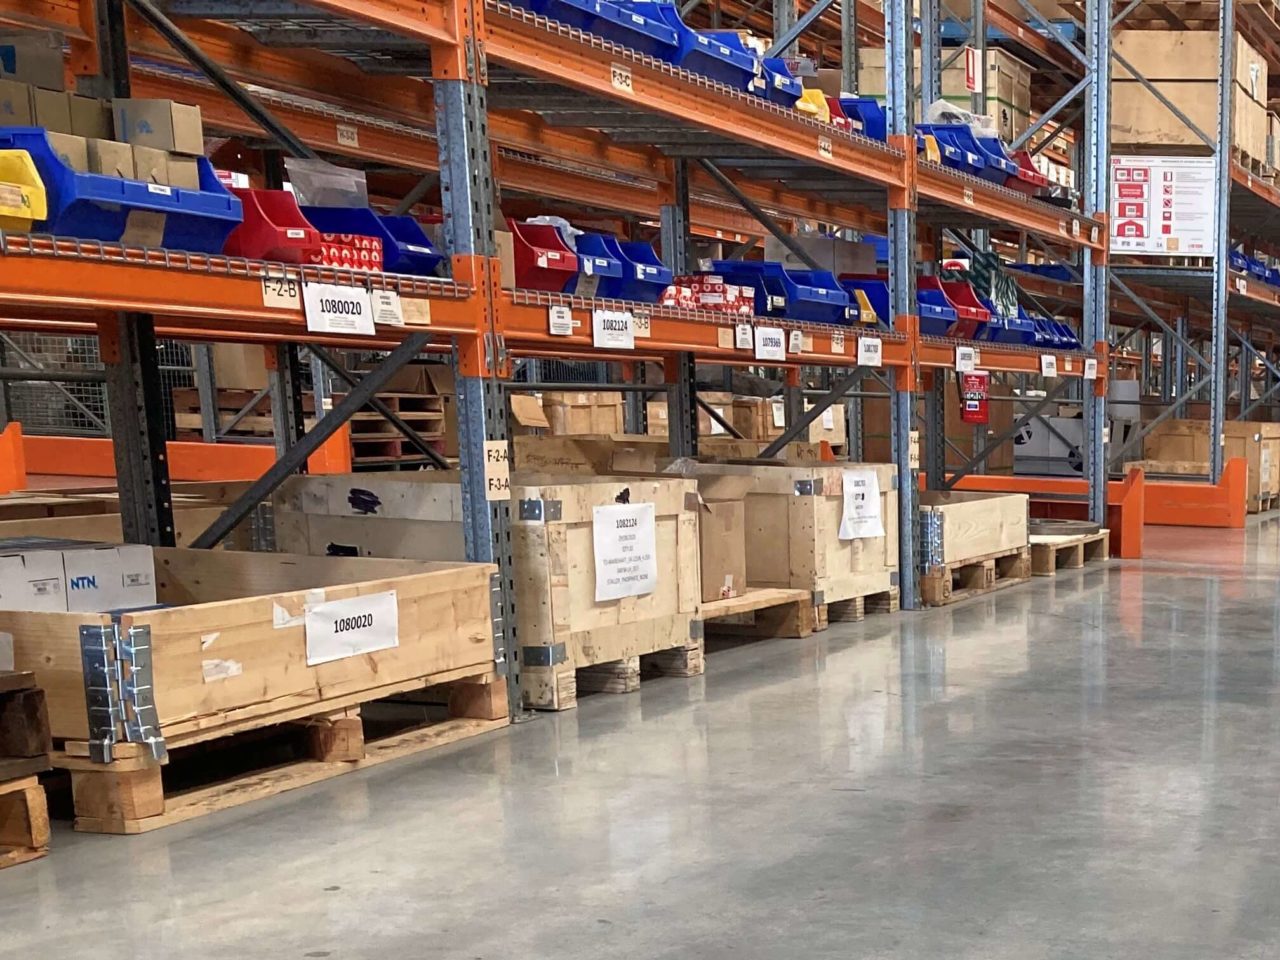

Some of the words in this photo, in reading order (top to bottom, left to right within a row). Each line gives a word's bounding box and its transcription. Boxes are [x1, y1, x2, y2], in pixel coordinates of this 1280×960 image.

[264, 278, 298, 298] F-2-B
[319, 298, 362, 315] 1080020
[602, 319, 628, 332] 1082124
[487, 449, 508, 462] F-2-A
[488, 478, 510, 491] F-3-A
[70, 575, 97, 590] NTN
[333, 613, 373, 634] 1080020
